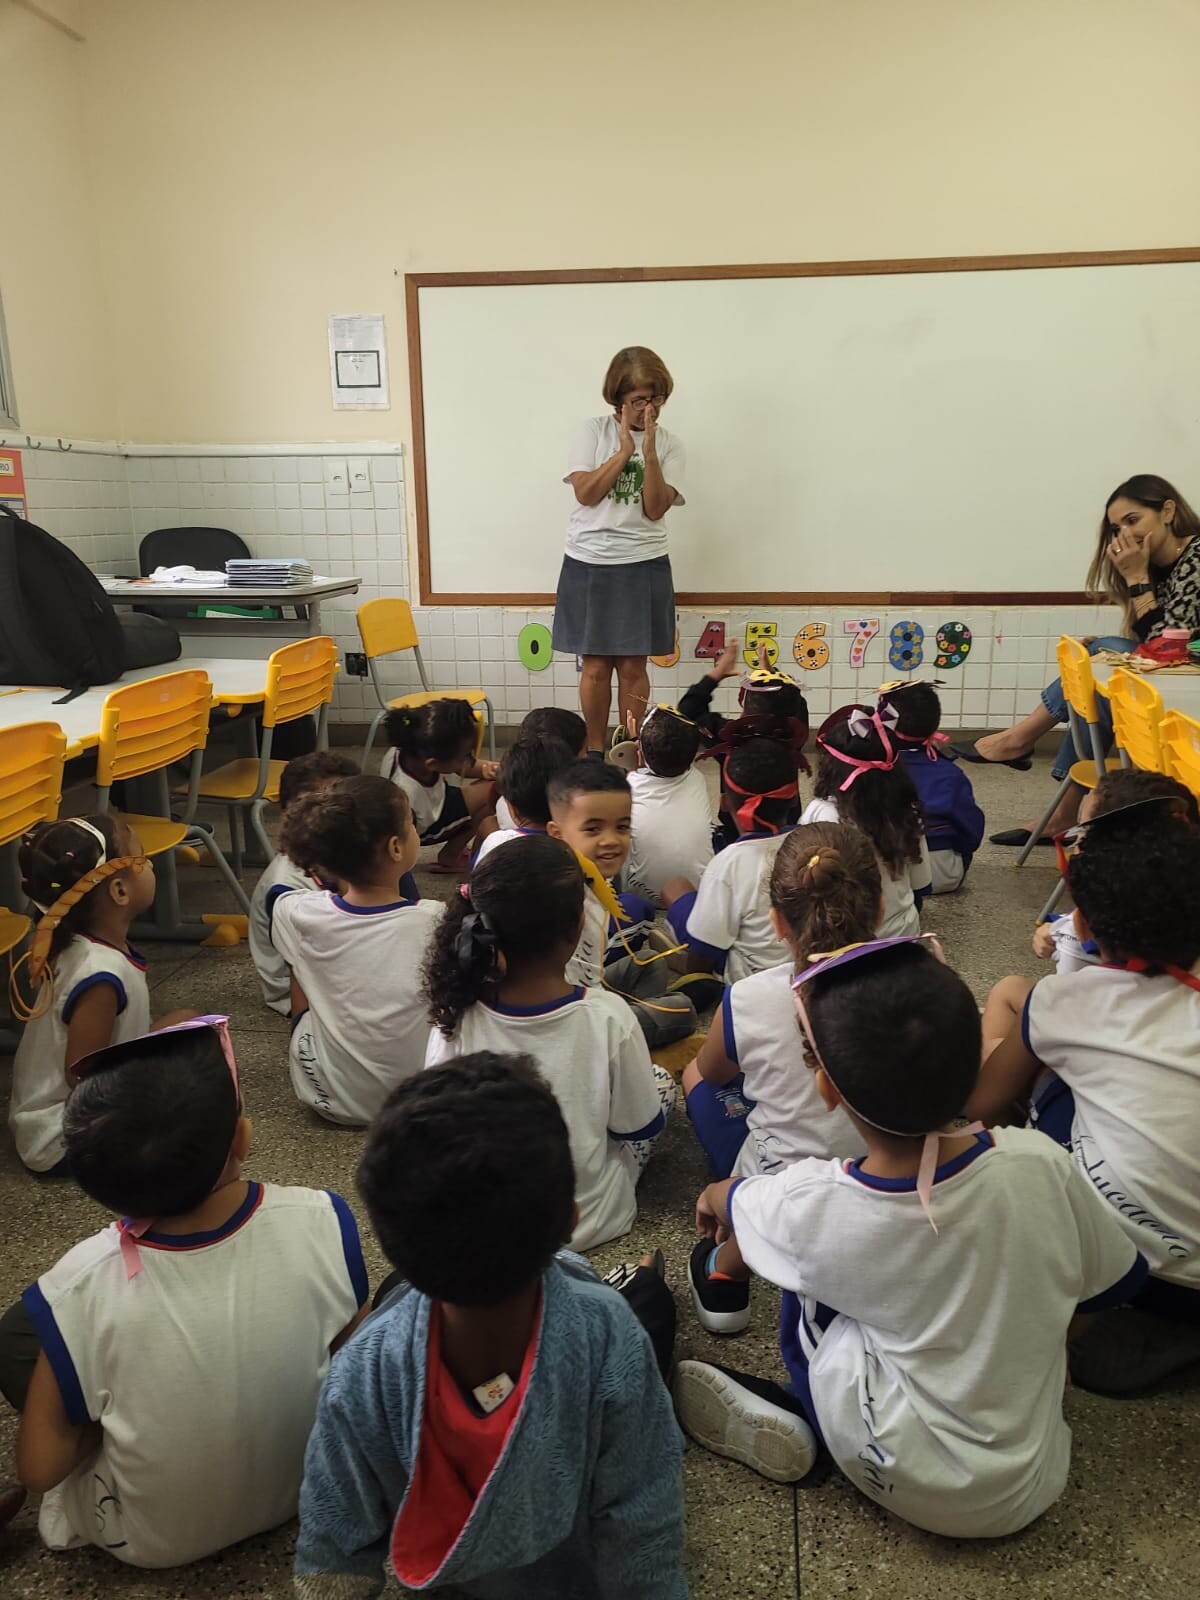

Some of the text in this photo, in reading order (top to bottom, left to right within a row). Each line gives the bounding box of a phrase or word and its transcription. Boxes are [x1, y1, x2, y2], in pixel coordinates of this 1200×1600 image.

[518, 622, 554, 671] 0
[694, 621, 726, 668] 4
[743, 621, 780, 670] 5
[793, 622, 830, 670] 6
[844, 618, 880, 668] 7
[889, 620, 925, 671] 8
[933, 621, 972, 669] 9
